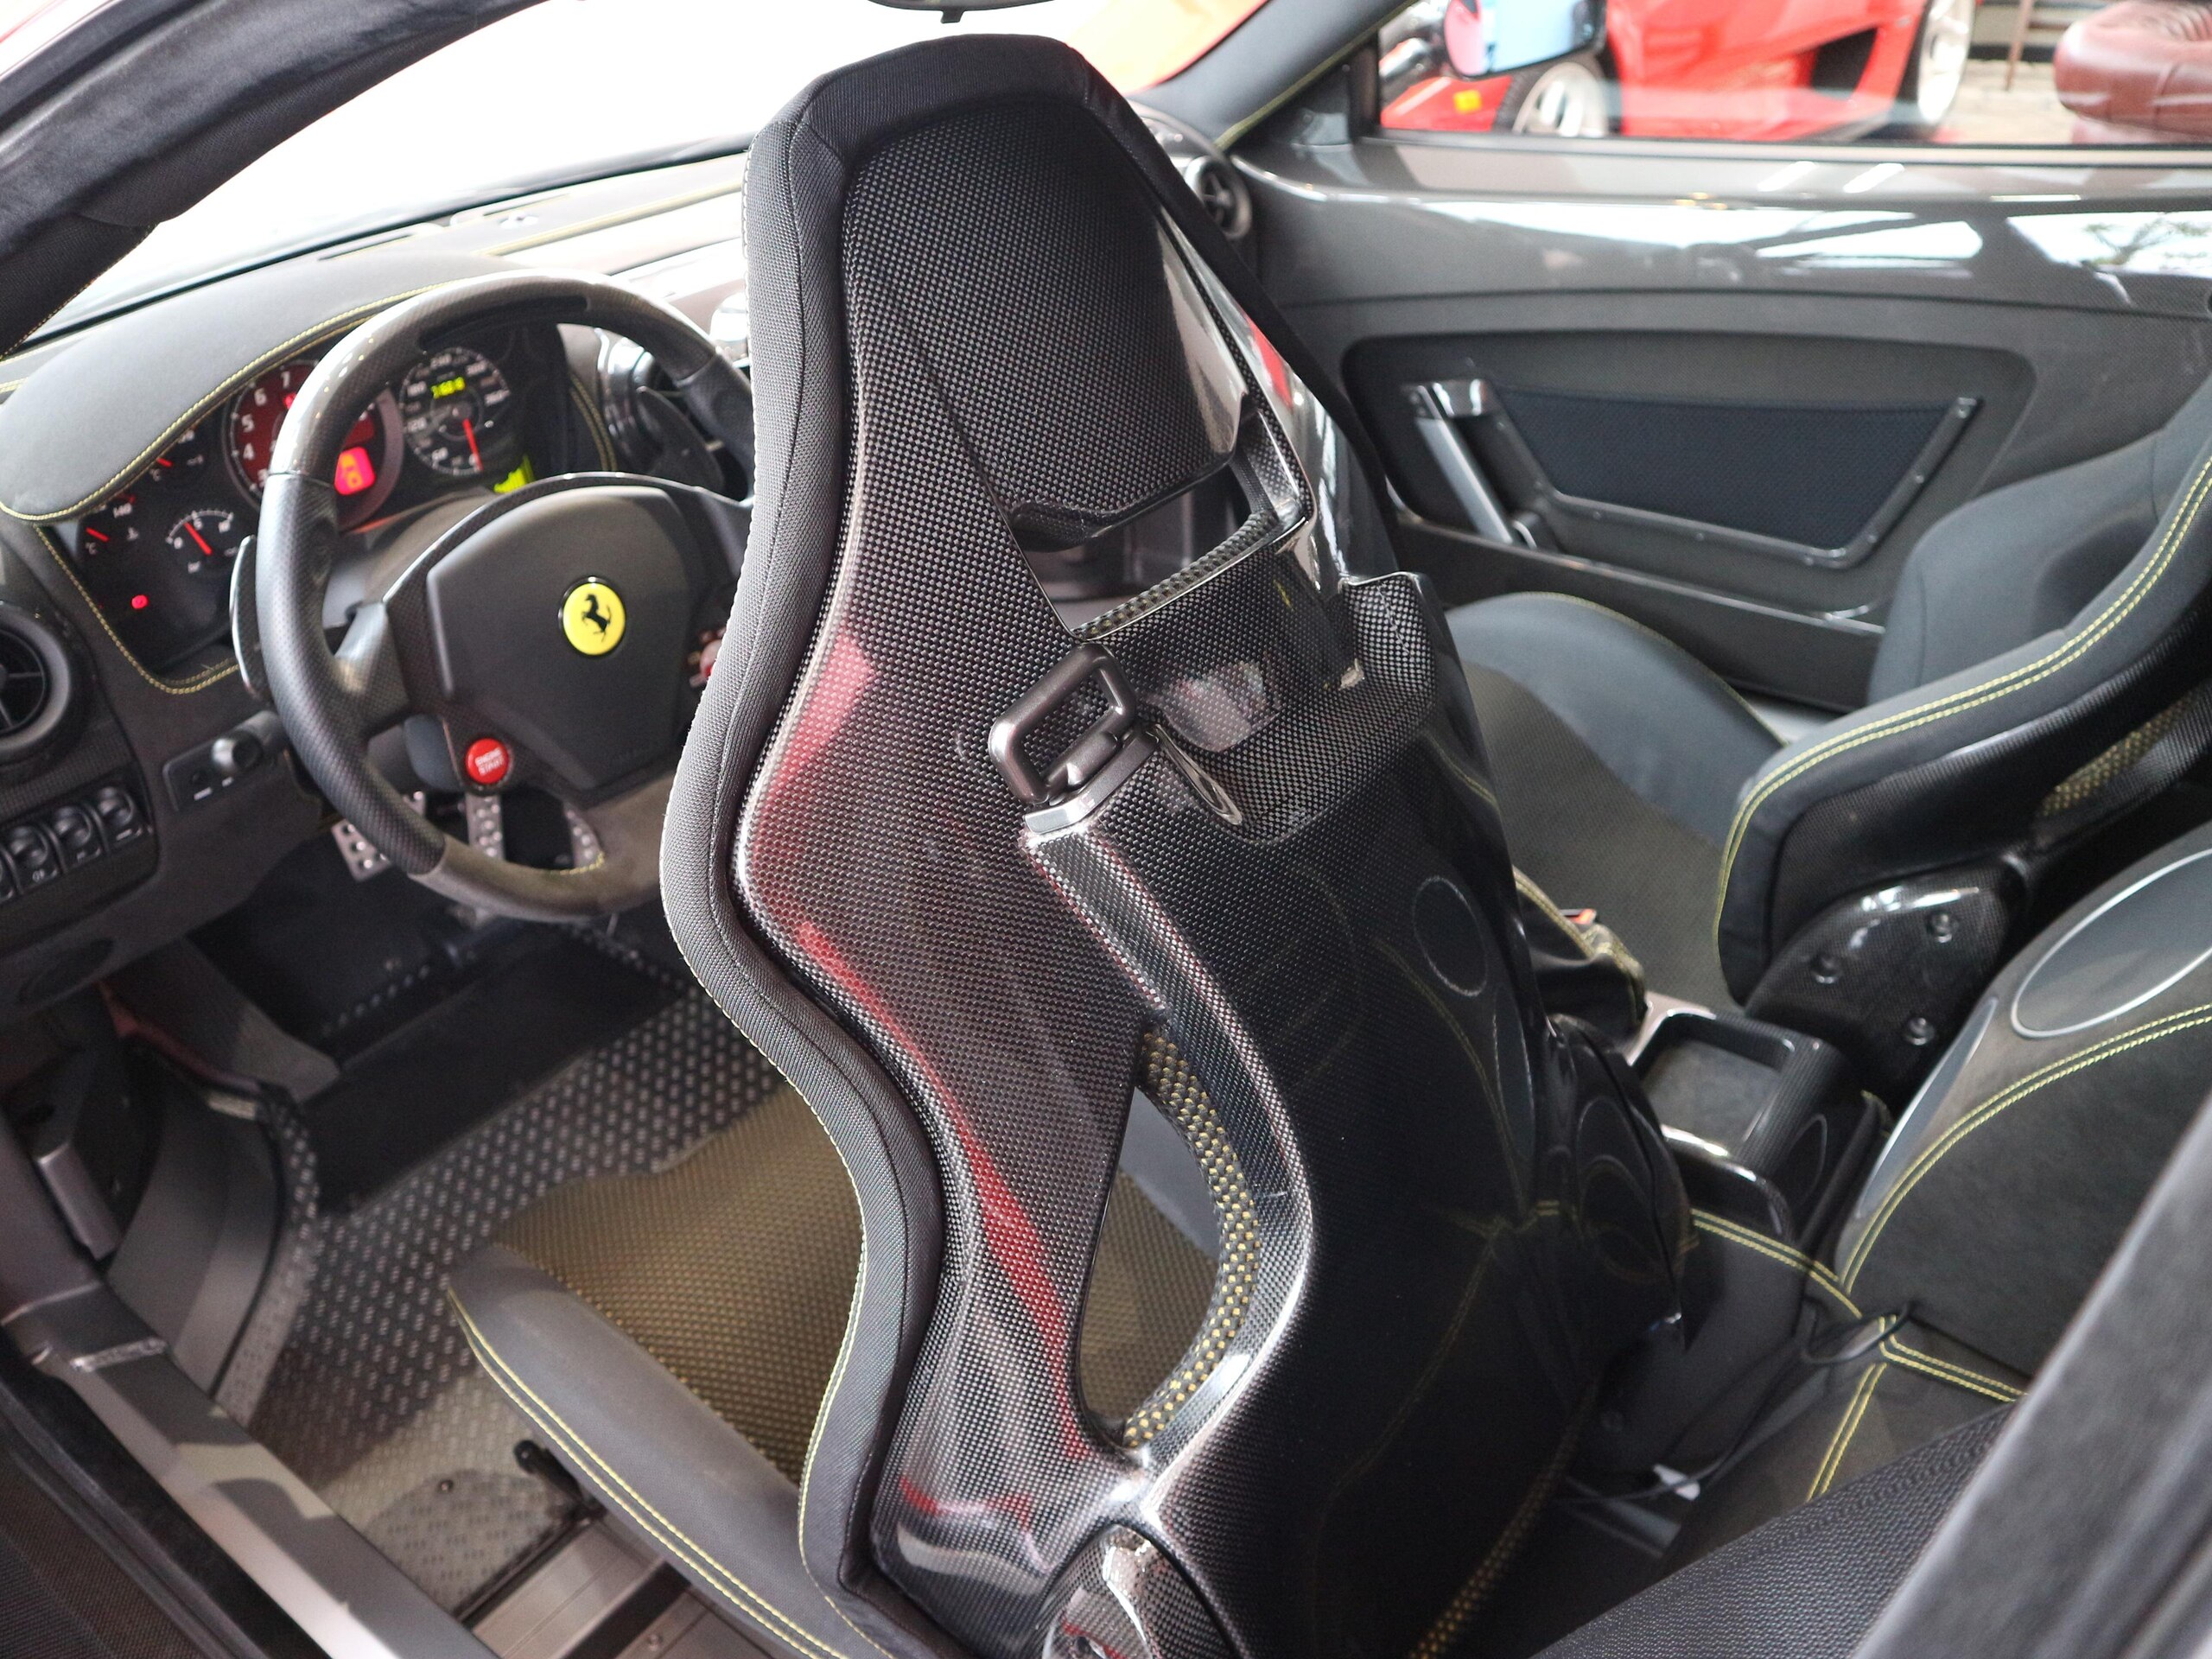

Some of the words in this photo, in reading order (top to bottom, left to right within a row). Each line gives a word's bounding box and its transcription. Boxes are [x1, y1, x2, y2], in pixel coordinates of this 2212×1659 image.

[254, 388, 268, 406] 6
[241, 414, 254, 432] 5
[243, 442, 255, 461] 4
